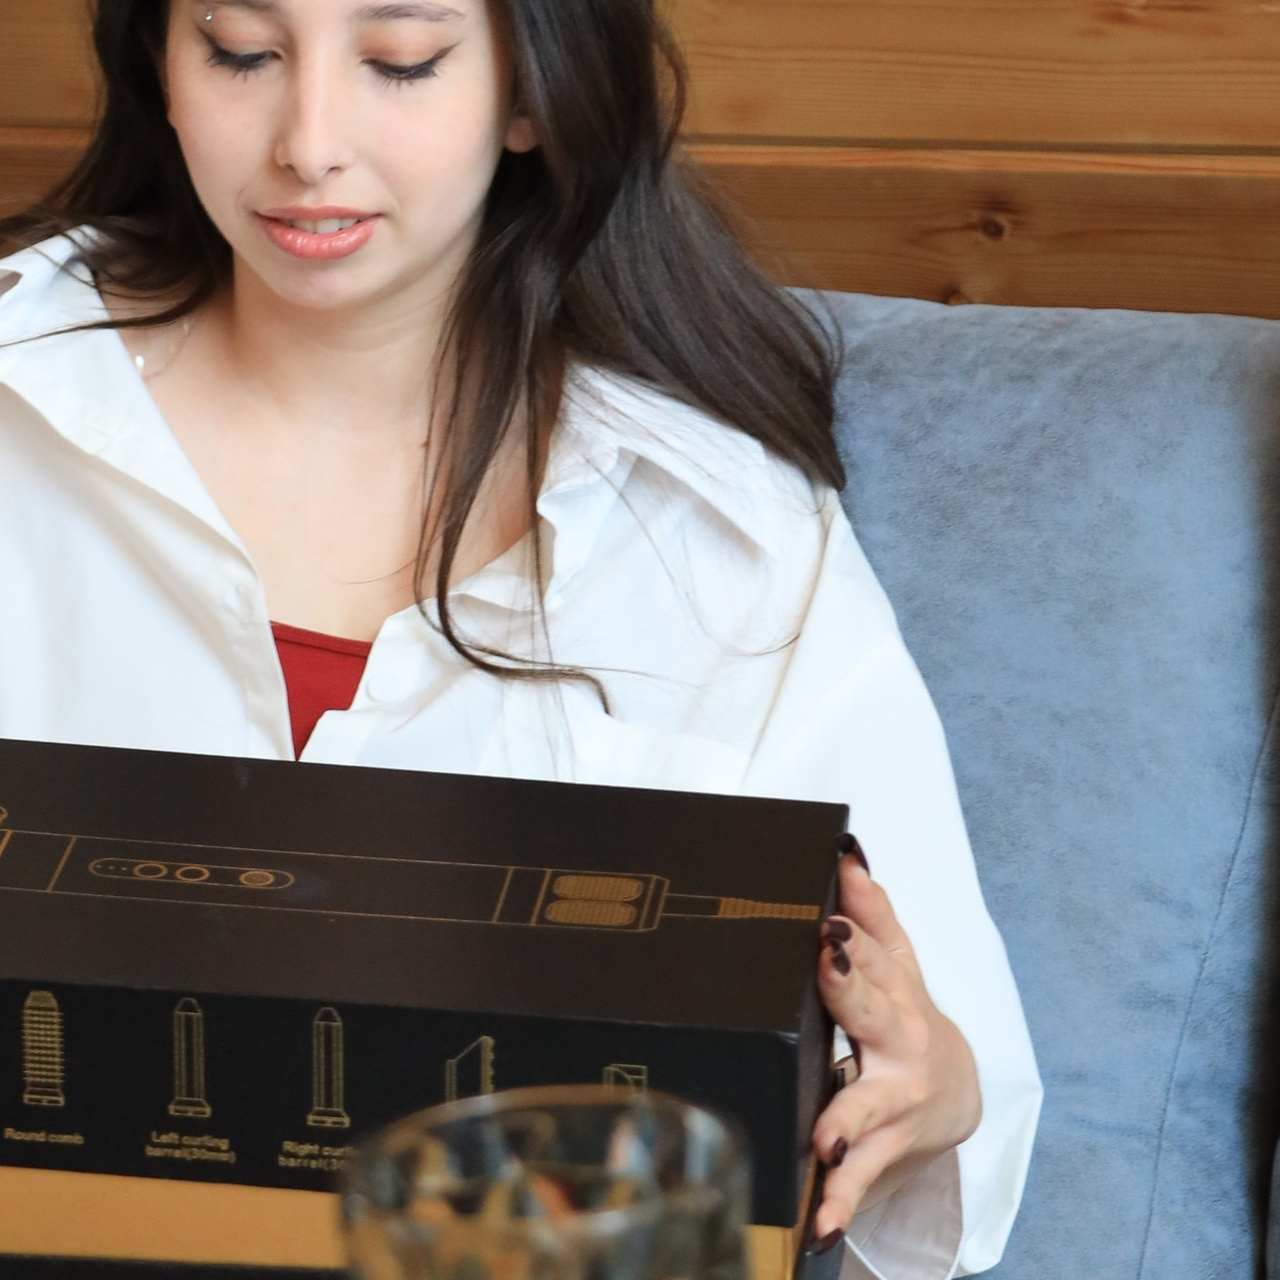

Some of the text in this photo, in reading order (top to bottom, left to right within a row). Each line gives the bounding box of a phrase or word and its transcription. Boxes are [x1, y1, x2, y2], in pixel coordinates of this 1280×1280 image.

[4, 1127, 85, 1145] Round comb
[151, 1130, 179, 1143] Left
[282, 1140, 320, 1156] Right
